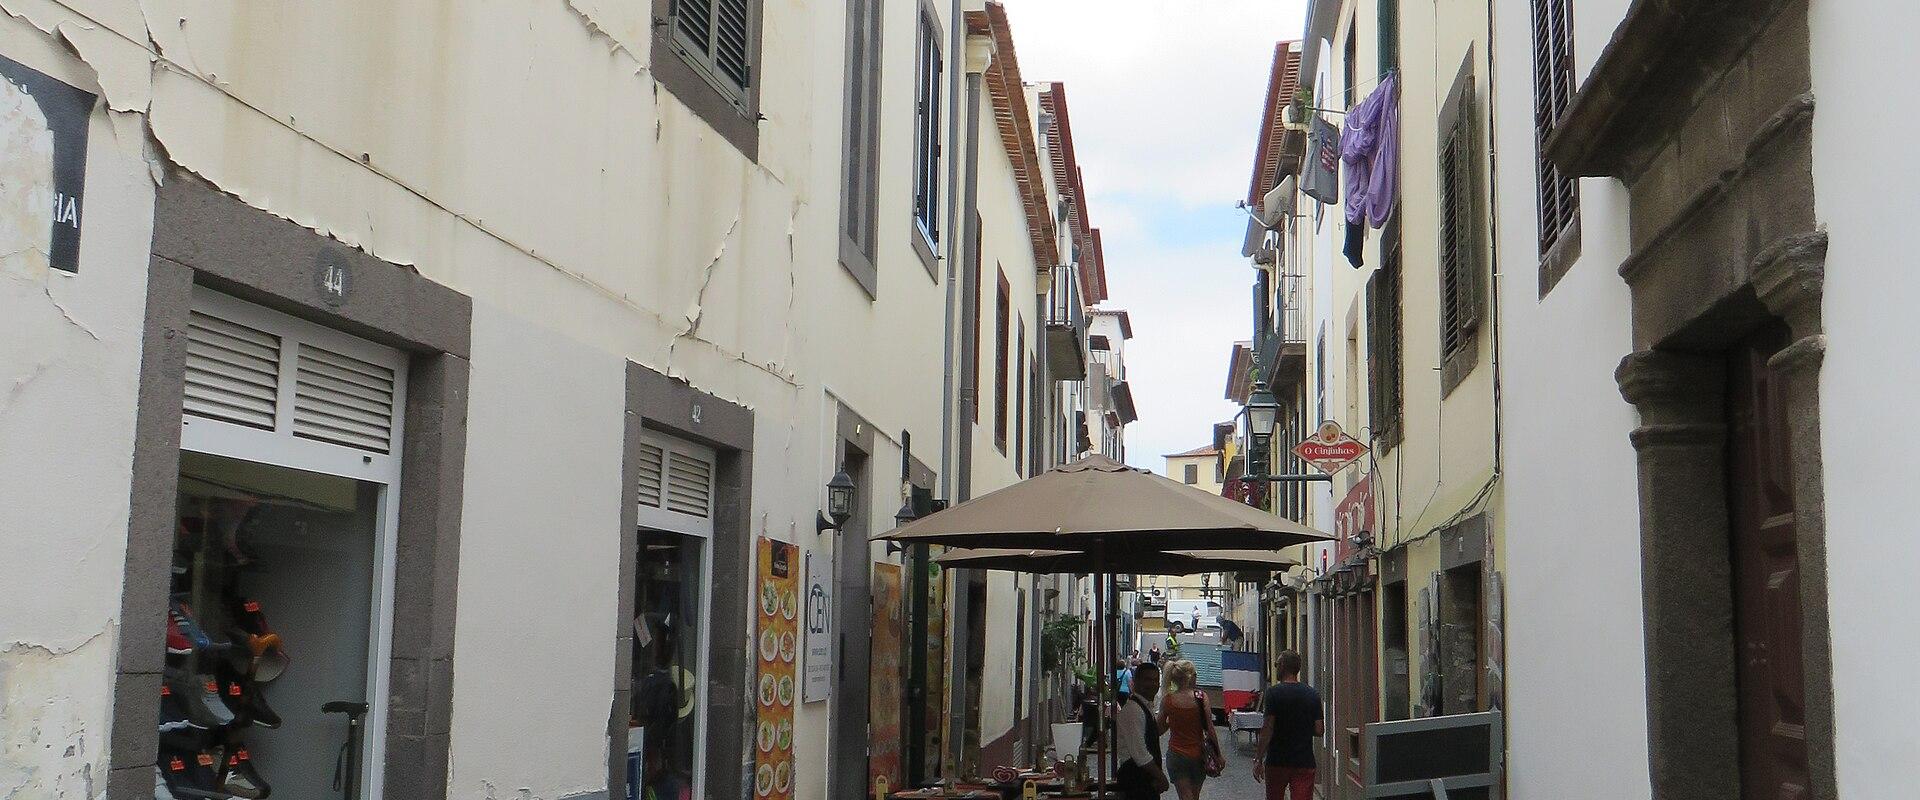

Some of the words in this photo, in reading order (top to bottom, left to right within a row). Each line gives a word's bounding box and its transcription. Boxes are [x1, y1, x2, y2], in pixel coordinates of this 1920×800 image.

[323, 265, 343, 297] 44
[692, 405, 701, 423] 42
[1304, 447, 1312, 455] O
